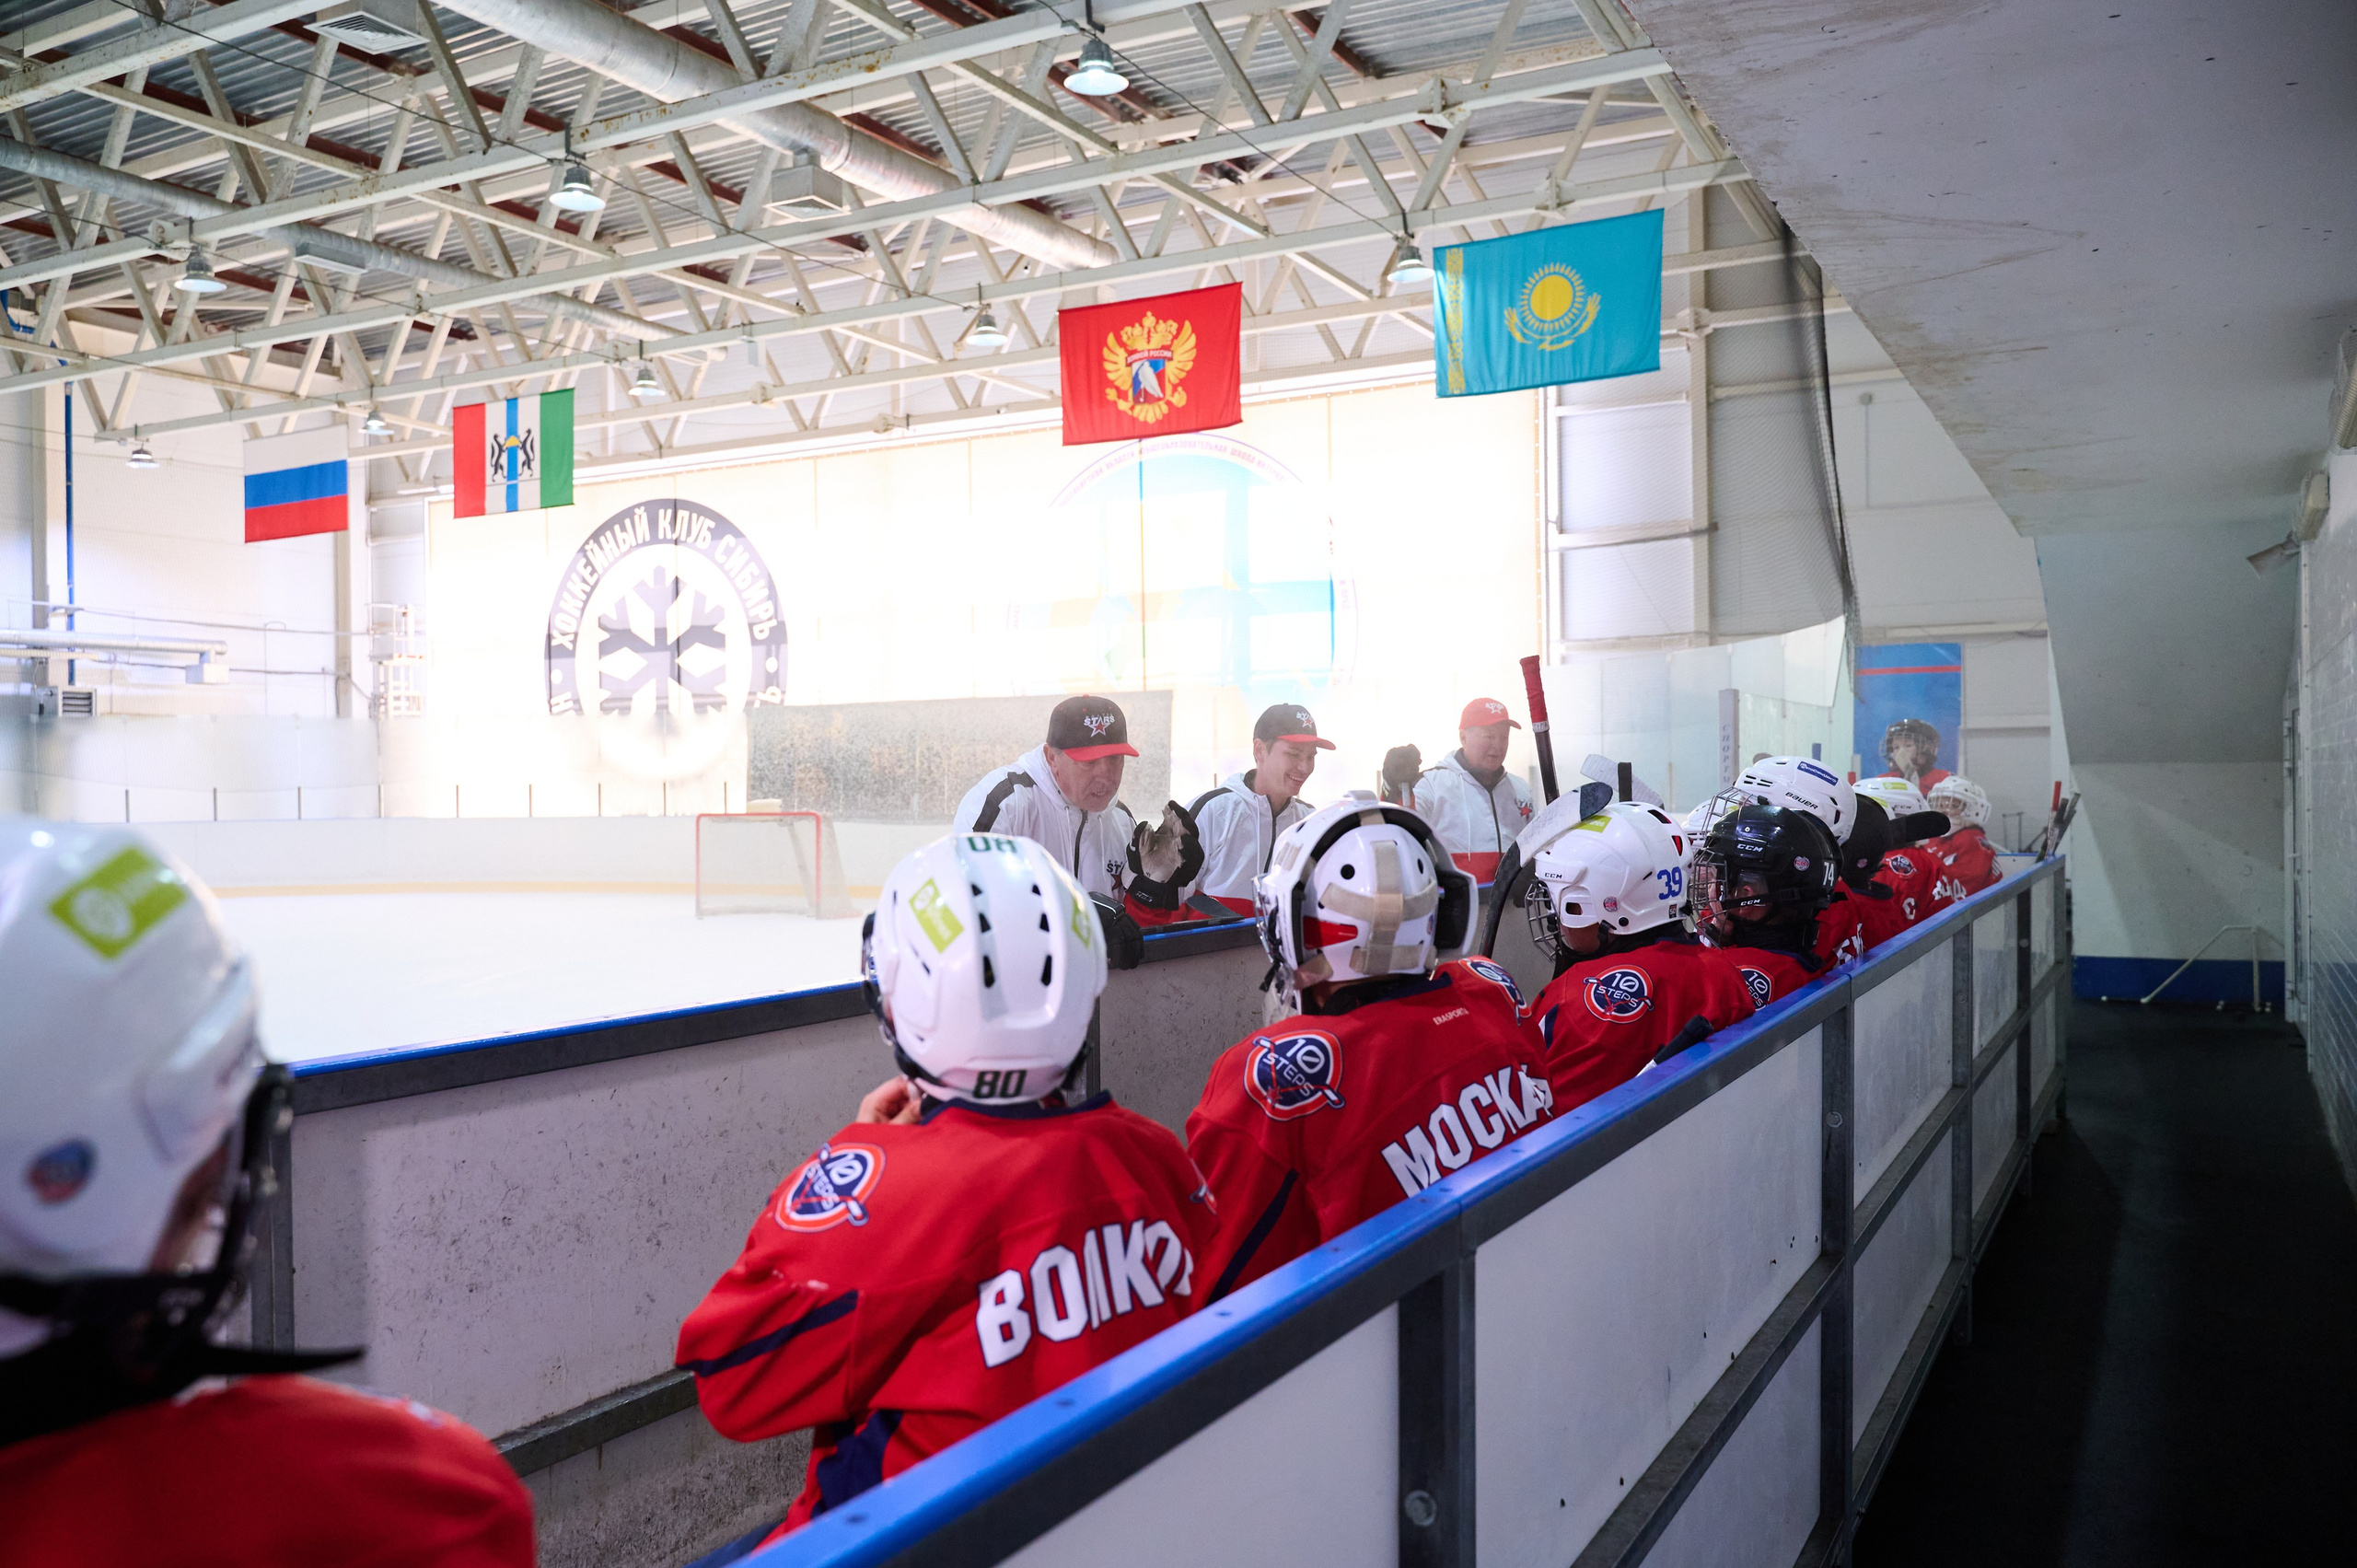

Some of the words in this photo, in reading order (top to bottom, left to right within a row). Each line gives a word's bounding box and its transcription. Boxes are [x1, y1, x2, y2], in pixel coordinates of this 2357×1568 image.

[552, 505, 651, 651] ХОККЕЙНЫЙ
[658, 508, 716, 551] КЛУБ
[714, 533, 778, 641] СИБИРЬ
[1084, 714, 1115, 726] STARS
[1736, 842, 1764, 854] CCM
[1656, 865, 1683, 900] 39
[1822, 860, 1836, 888] 74
[1740, 898, 1761, 907] CCM
[1596, 985, 1639, 1008] STEPS
[1611, 972, 1640, 993] 10
[1748, 971, 1769, 994] 10
[1285, 1038, 1325, 1074] 10
[972, 1069, 1028, 1099] 80
[1262, 1052, 1315, 1097] STEPS
[825, 1153, 864, 1186] 10
